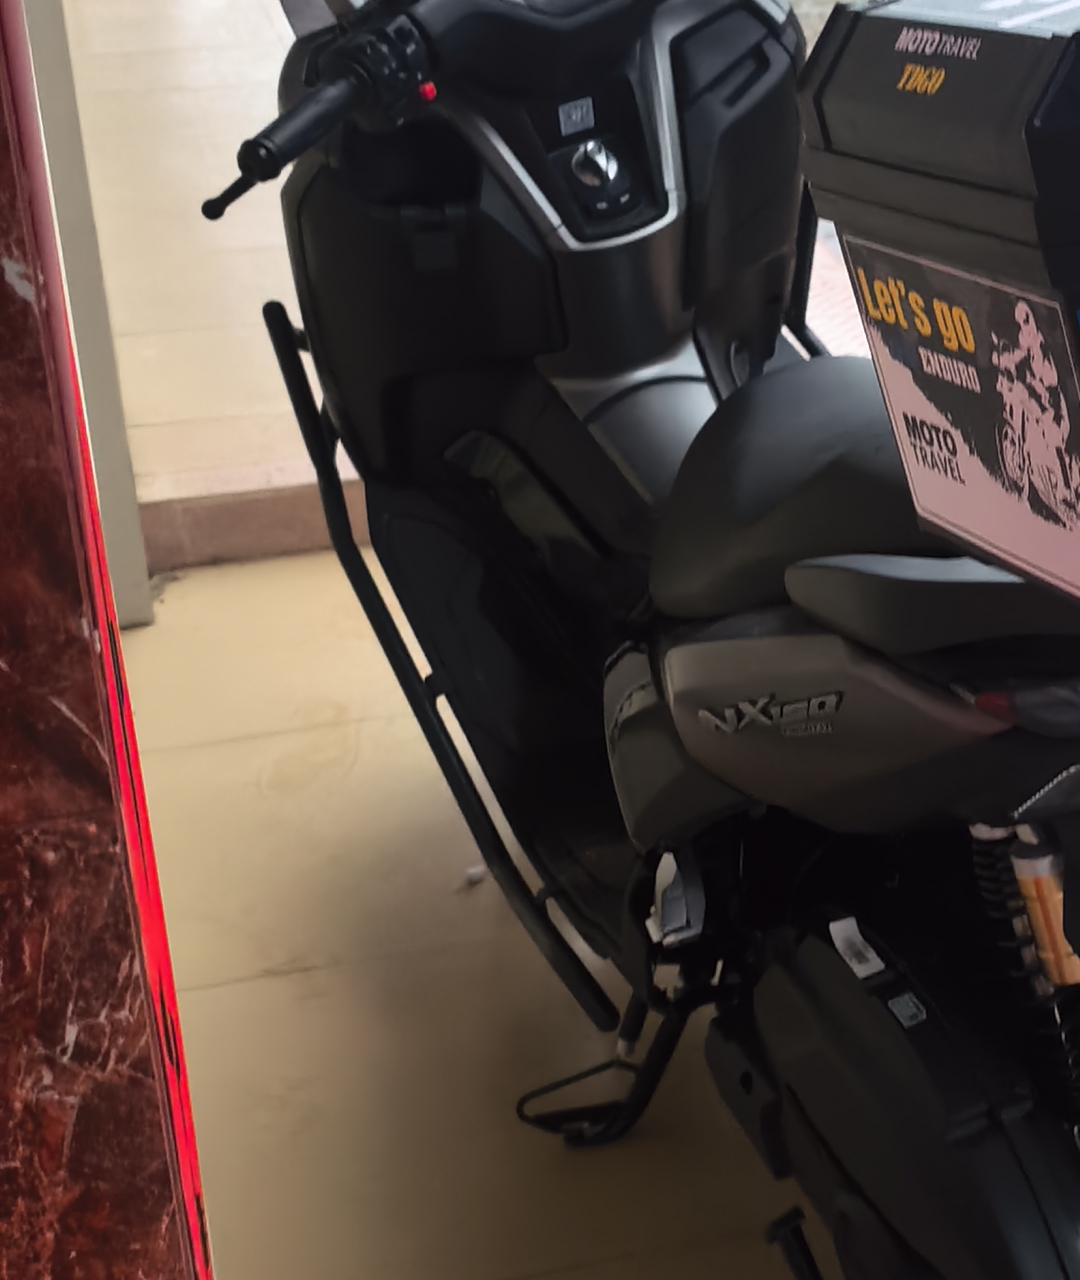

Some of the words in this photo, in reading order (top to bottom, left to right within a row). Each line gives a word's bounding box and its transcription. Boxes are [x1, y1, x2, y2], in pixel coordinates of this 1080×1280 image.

[857, 266, 931, 337] Let's
[933, 298, 975, 354] go
[918, 345, 981, 394] ENDURO
[902, 411, 958, 458] MOTO
[910, 441, 966, 486] TRAVEL
